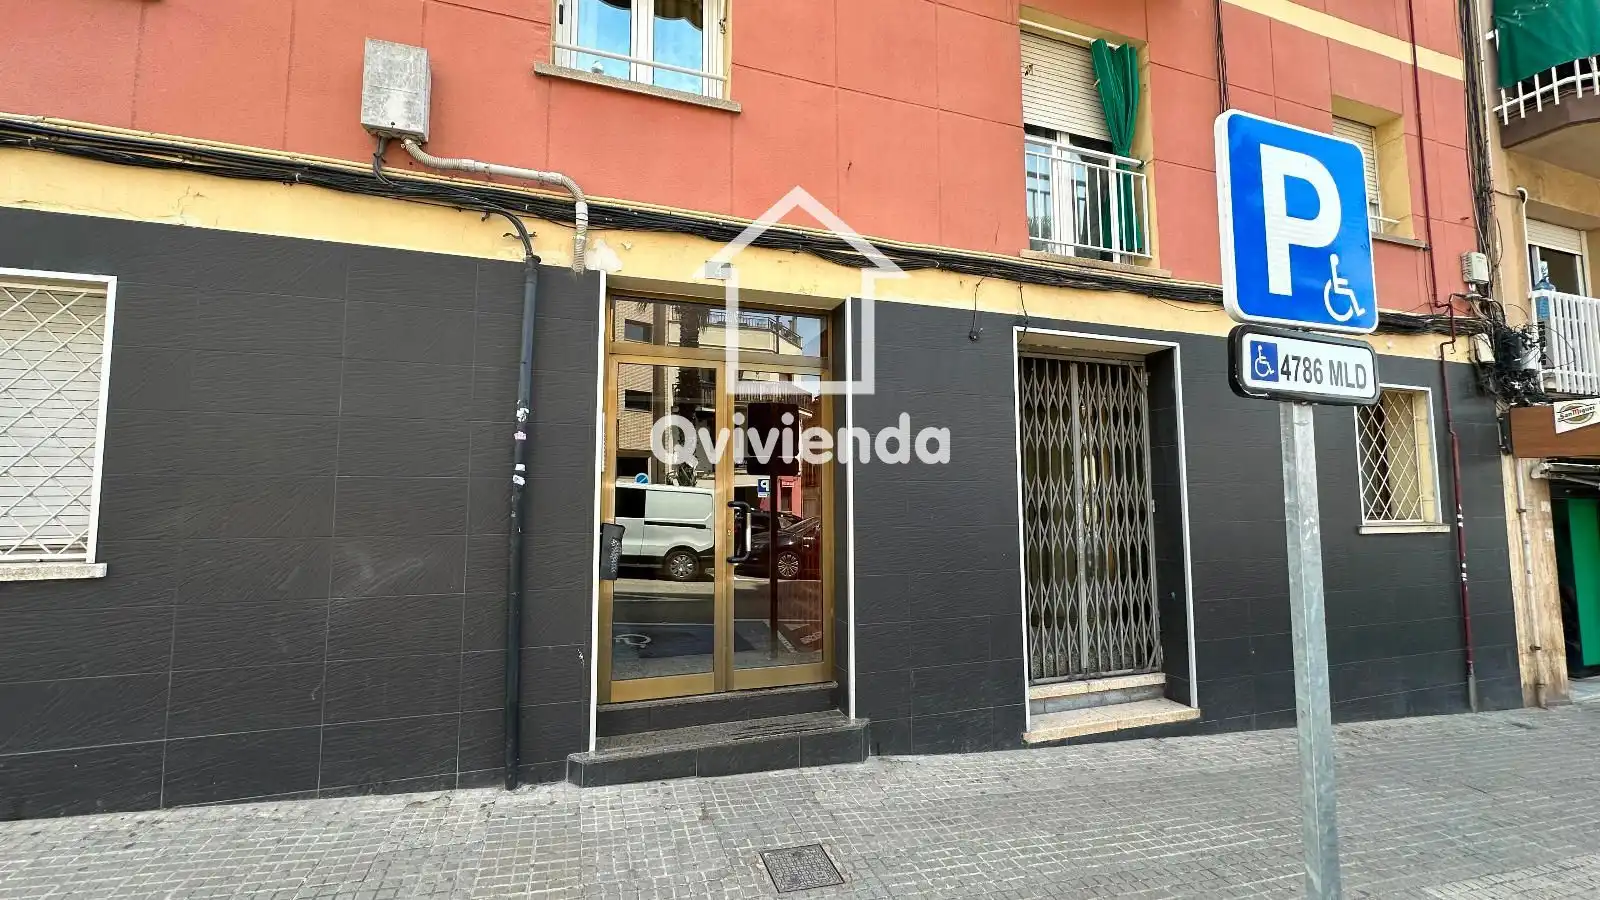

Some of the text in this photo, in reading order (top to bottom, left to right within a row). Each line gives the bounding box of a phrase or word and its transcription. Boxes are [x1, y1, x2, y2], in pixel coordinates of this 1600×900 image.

[1260, 143, 1342, 296] P
[1280, 354, 1367, 389] 4786 MLD
